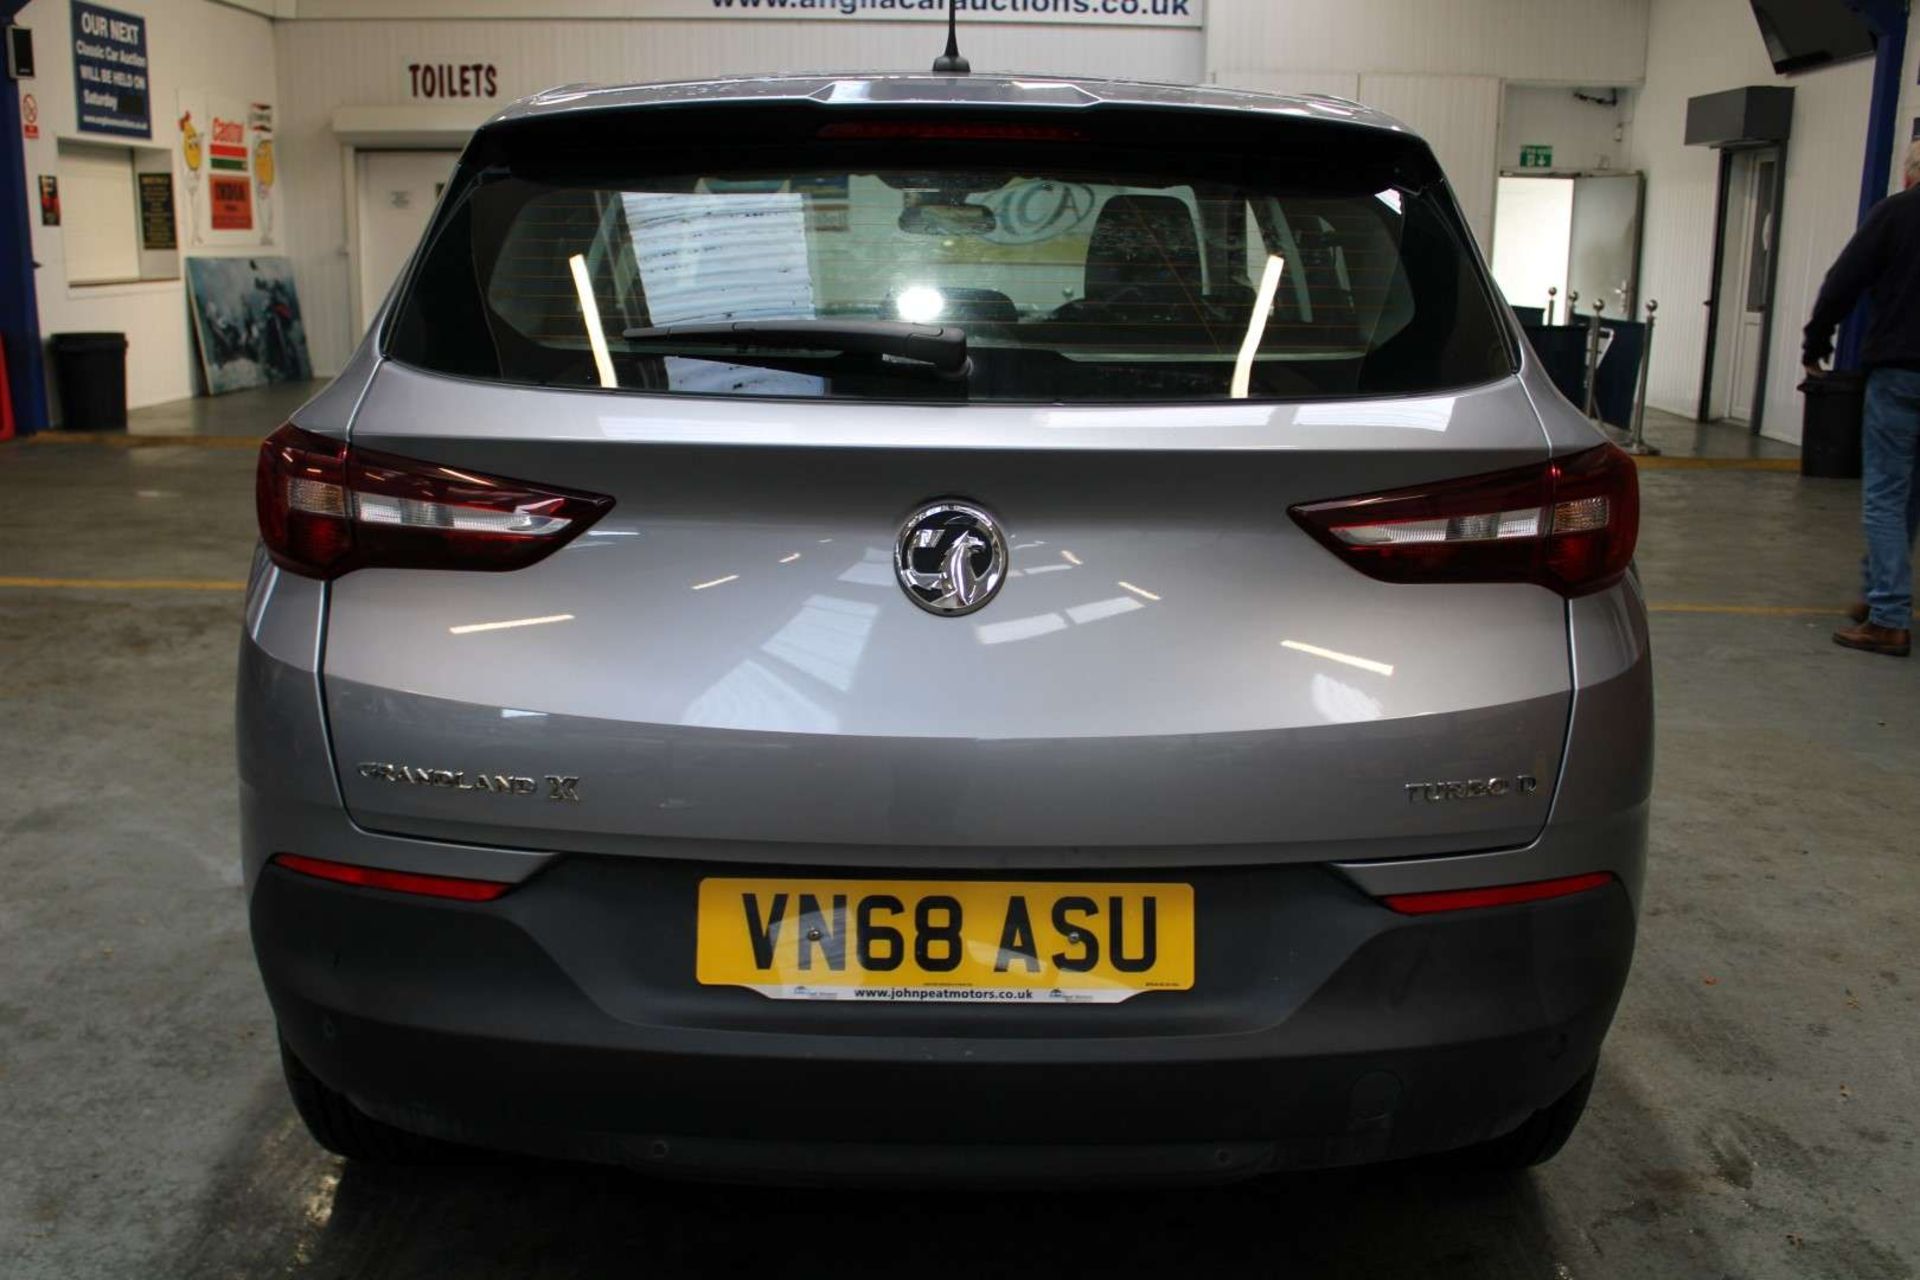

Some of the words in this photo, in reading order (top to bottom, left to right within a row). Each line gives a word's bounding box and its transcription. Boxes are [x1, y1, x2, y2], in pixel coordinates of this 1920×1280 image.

[81, 12, 109, 39] OUR
[109, 19, 139, 45] NEXT
[76, 40, 105, 59] Classic
[105, 46, 119, 61] Car
[80, 65, 101, 82] WILL
[101, 68, 113, 84] BE
[113, 72, 133, 88] HELD
[133, 75, 146, 90] ON
[408, 64, 498, 98] TOILETS
[83, 89, 118, 111] Saturday
[357, 761, 538, 794] GRANDLAND
[544, 774, 580, 802] X
[1404, 776, 1510, 803] TURBO
[1516, 773, 1537, 795] D
[741, 892, 964, 973] VN68
[993, 895, 1158, 973] ASU
[854, 987, 1034, 1000] www.johnpeatmotors.co.uk
